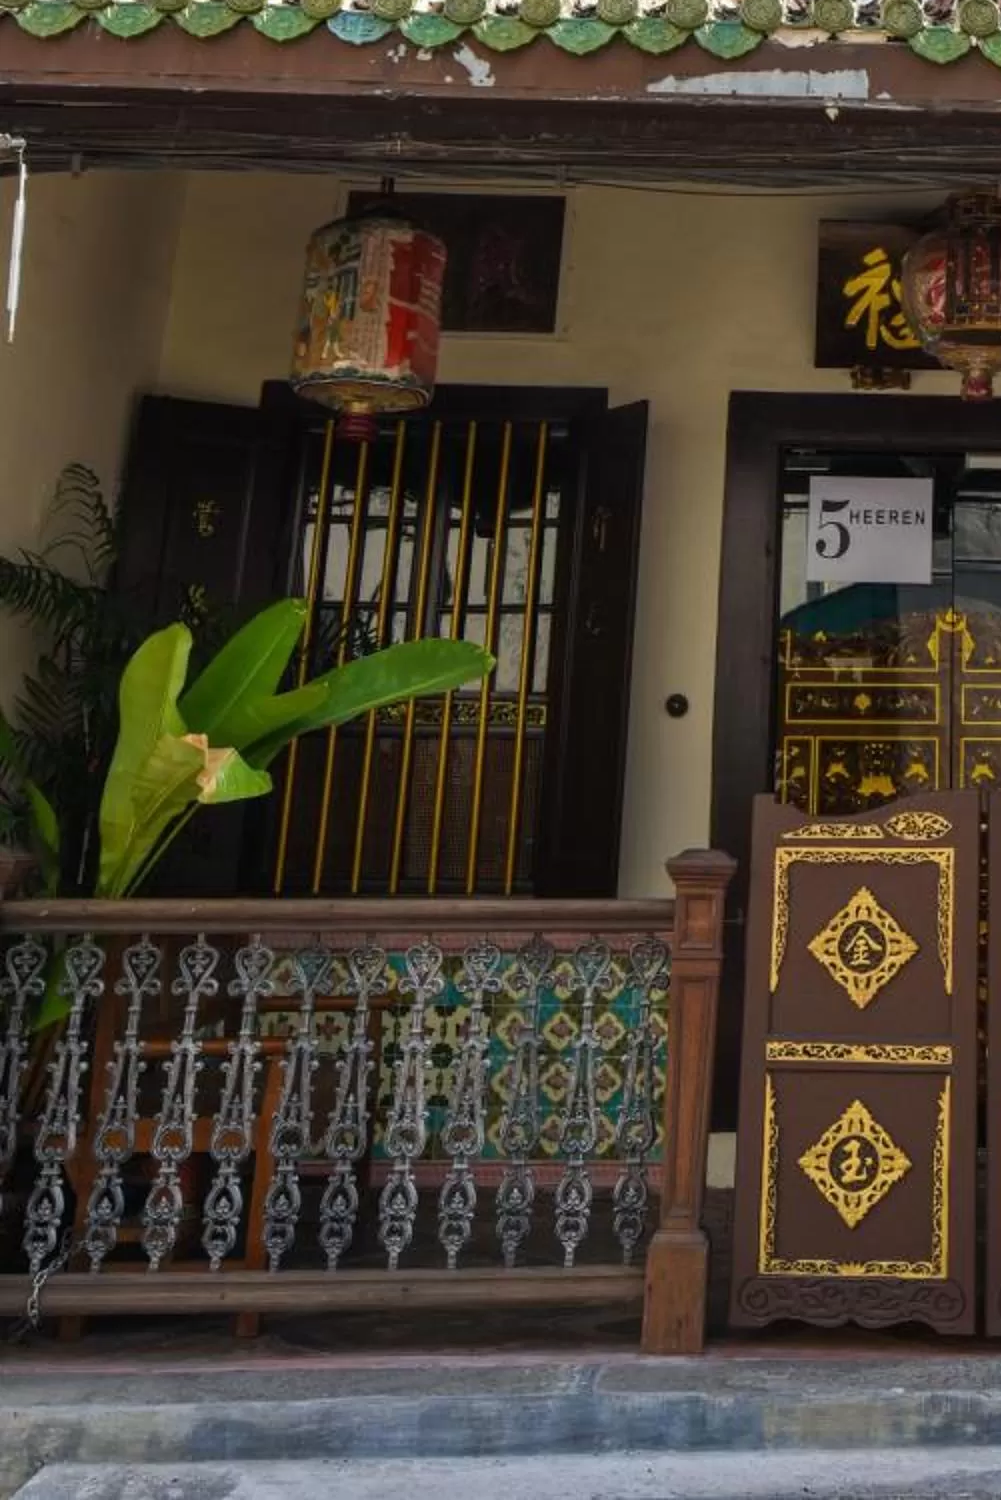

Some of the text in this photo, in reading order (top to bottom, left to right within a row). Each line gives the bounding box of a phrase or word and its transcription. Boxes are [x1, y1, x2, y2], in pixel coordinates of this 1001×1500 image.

[816, 499, 926, 559] 5 HEEREN
[843, 925, 883, 966] 金
[839, 1139, 874, 1185] 玉
